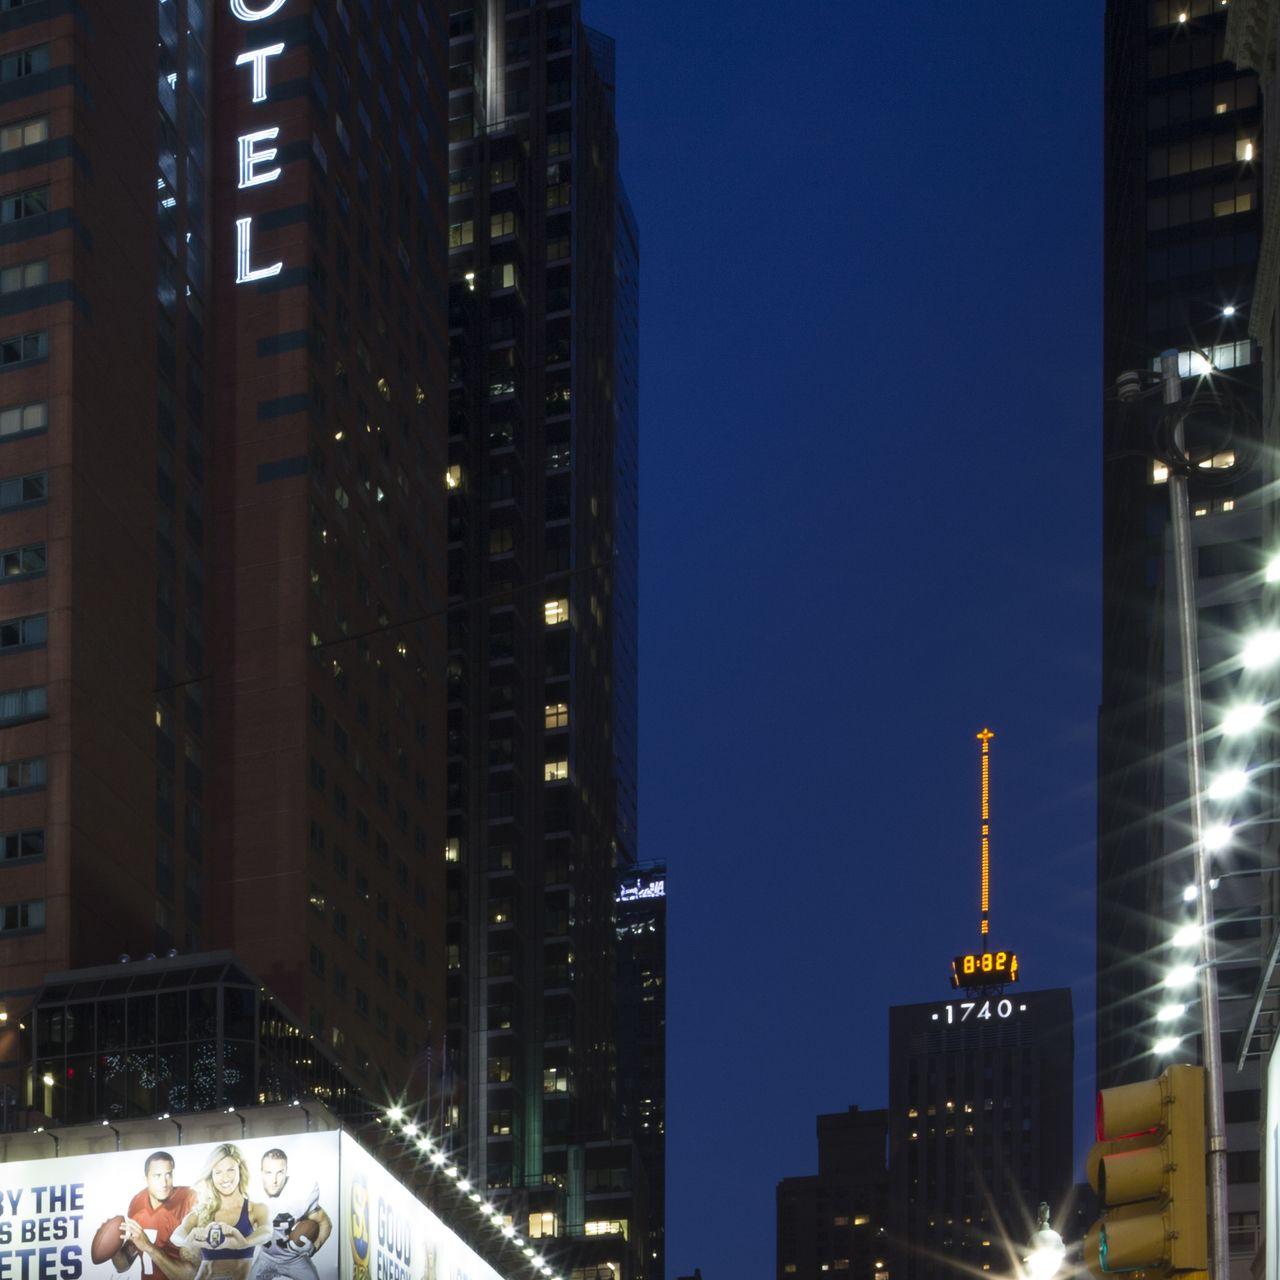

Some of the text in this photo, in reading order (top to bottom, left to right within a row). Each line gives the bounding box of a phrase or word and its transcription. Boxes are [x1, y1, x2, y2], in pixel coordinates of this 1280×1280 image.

[945, 999, 1013, 1024] 1740
[33, 1183, 85, 1213] THE
[21, 1216, 84, 1244] BEST
[377, 1196, 412, 1268] GOOD
